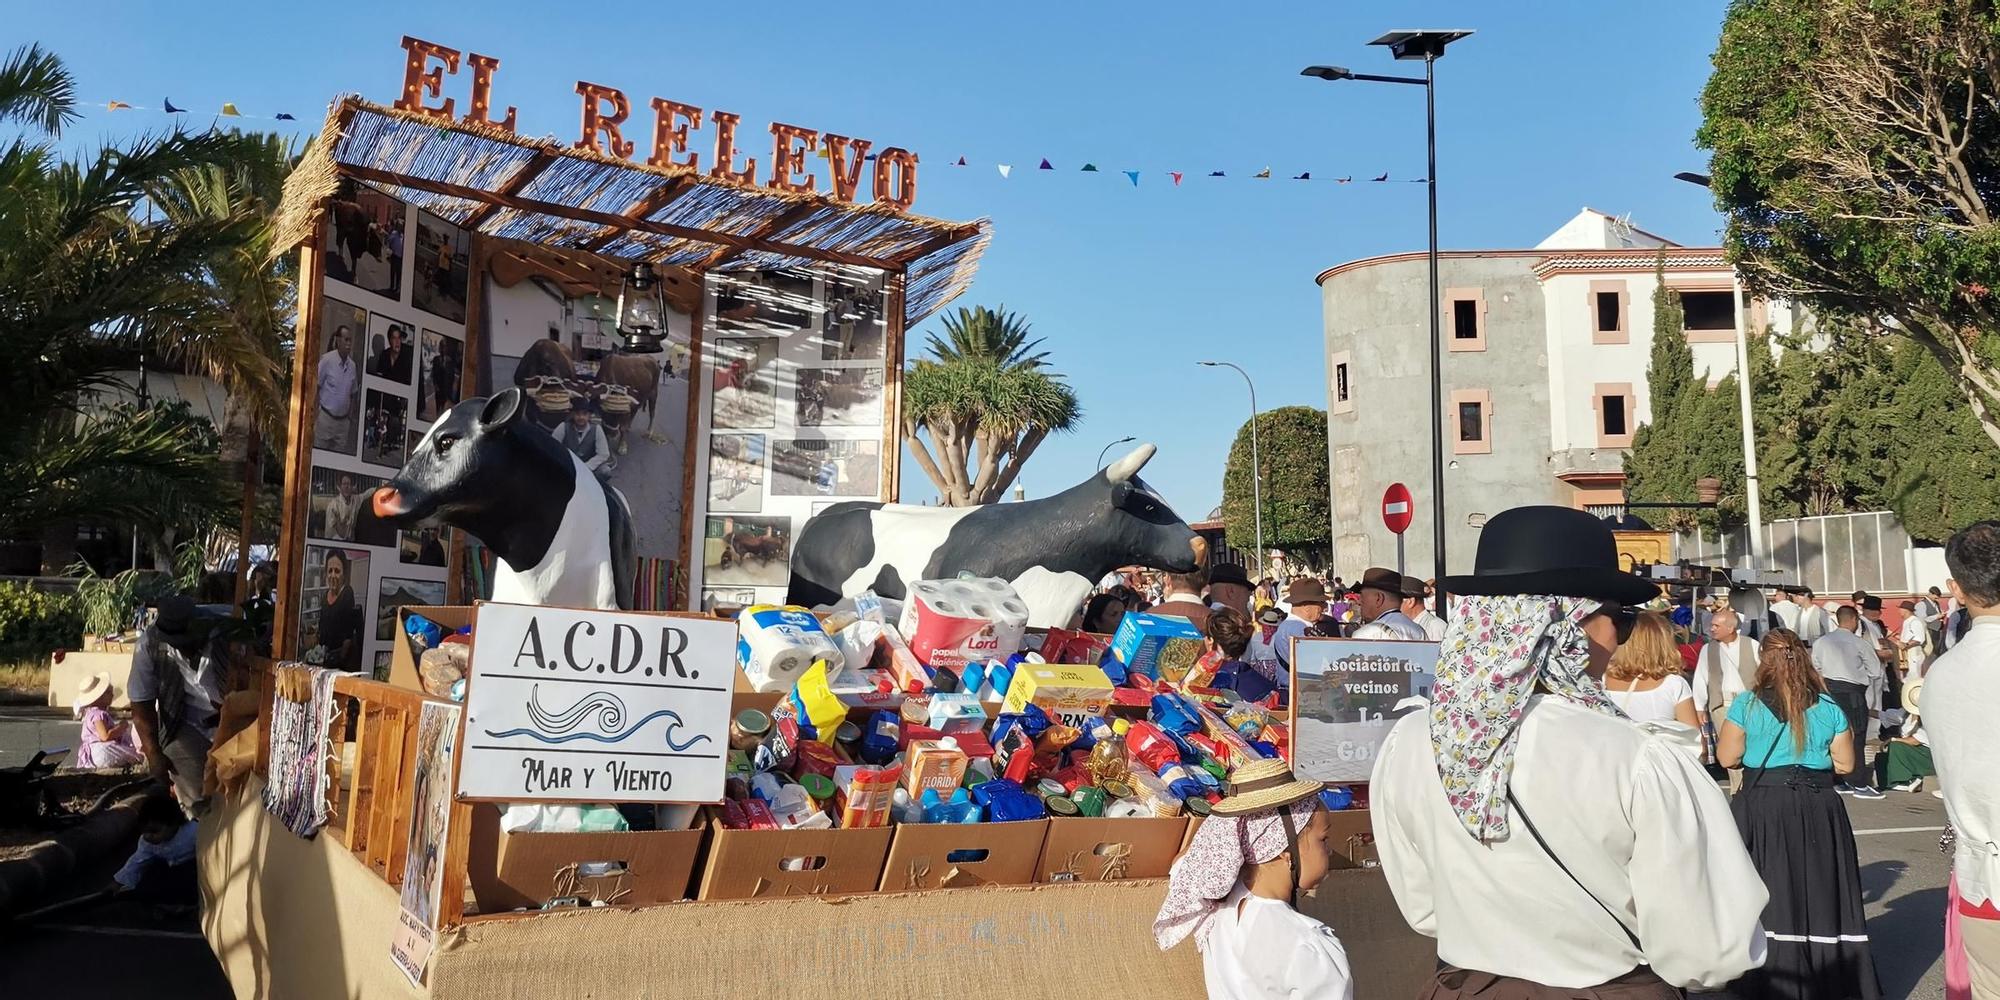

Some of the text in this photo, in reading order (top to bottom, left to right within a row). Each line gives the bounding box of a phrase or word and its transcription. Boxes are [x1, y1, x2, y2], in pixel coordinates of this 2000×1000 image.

[393, 35, 920, 212] EL RELEVO
[513, 616, 699, 679] A.C.D.R.
[931, 648, 959, 657] papel
[1321, 656, 1422, 673] Asociación de
[1344, 681, 1399, 694] vecinos
[1358, 707, 1385, 729] La
[922, 776, 957, 788] FLORIDA
